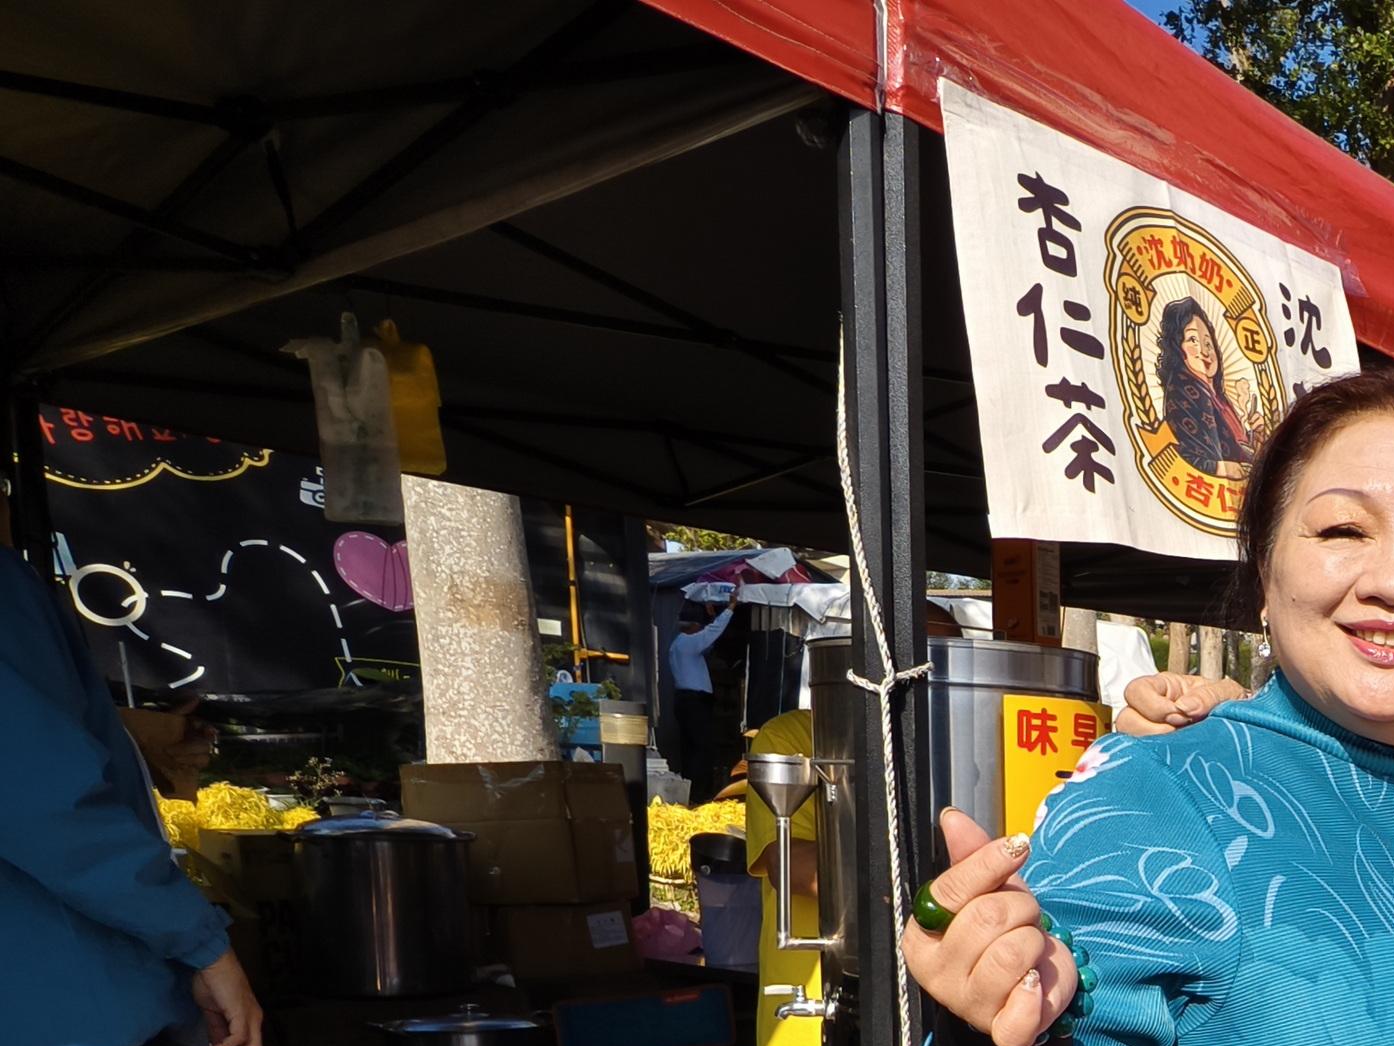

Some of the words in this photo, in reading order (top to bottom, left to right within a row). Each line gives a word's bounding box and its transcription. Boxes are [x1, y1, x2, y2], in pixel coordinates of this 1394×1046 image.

[1142, 234, 1226, 294] 沈奶奶
[1016, 171, 1118, 494] 杏仁茶
[1241, 325, 1264, 356] 正
[1278, 281, 1333, 402] 沈
[1185, 471, 1249, 514] 杏仁
[1017, 707, 1112, 756] 味早
